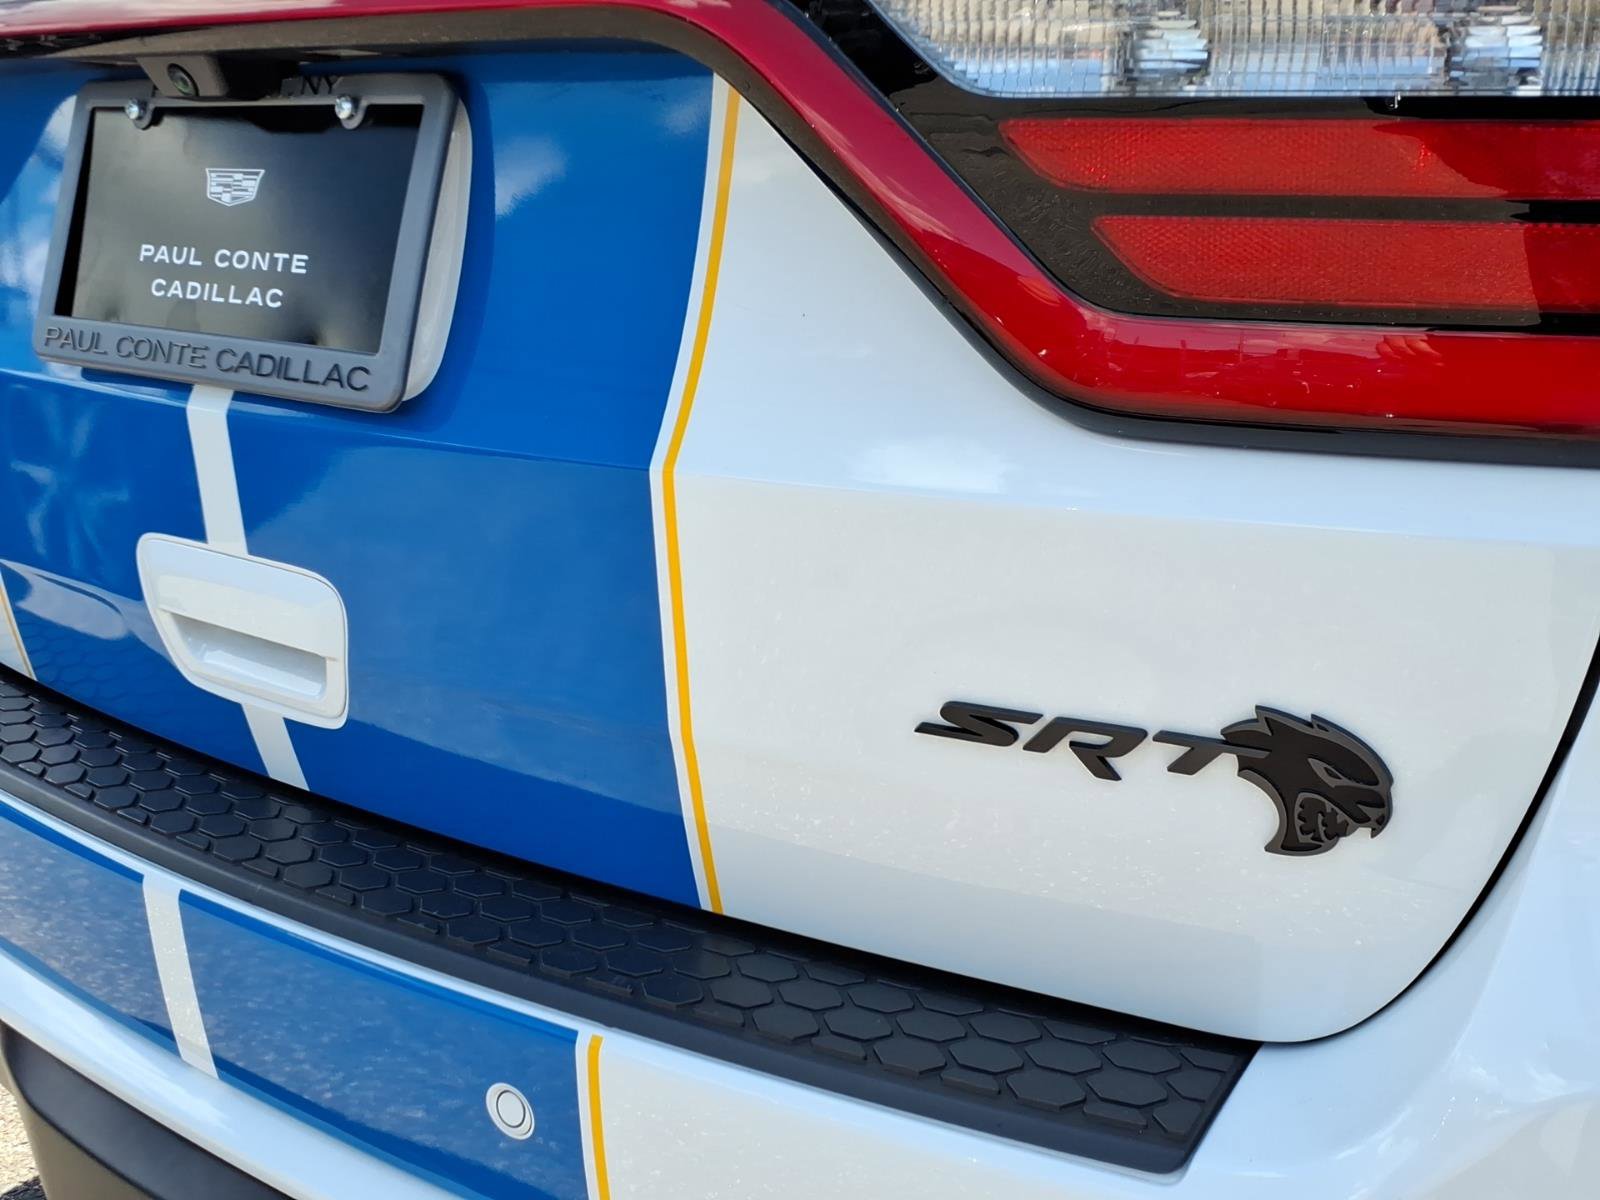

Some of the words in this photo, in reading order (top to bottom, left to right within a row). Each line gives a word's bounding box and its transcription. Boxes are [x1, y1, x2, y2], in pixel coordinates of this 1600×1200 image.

[139, 243, 203, 266] PAUL
[214, 249, 309, 274] CONTE
[151, 278, 284, 308] CADILLAC
[44, 327, 109, 355] PAUL
[116, 336, 209, 369] CONTE
[215, 347, 372, 391] CADILLAC
[914, 700, 1271, 781] SRT
